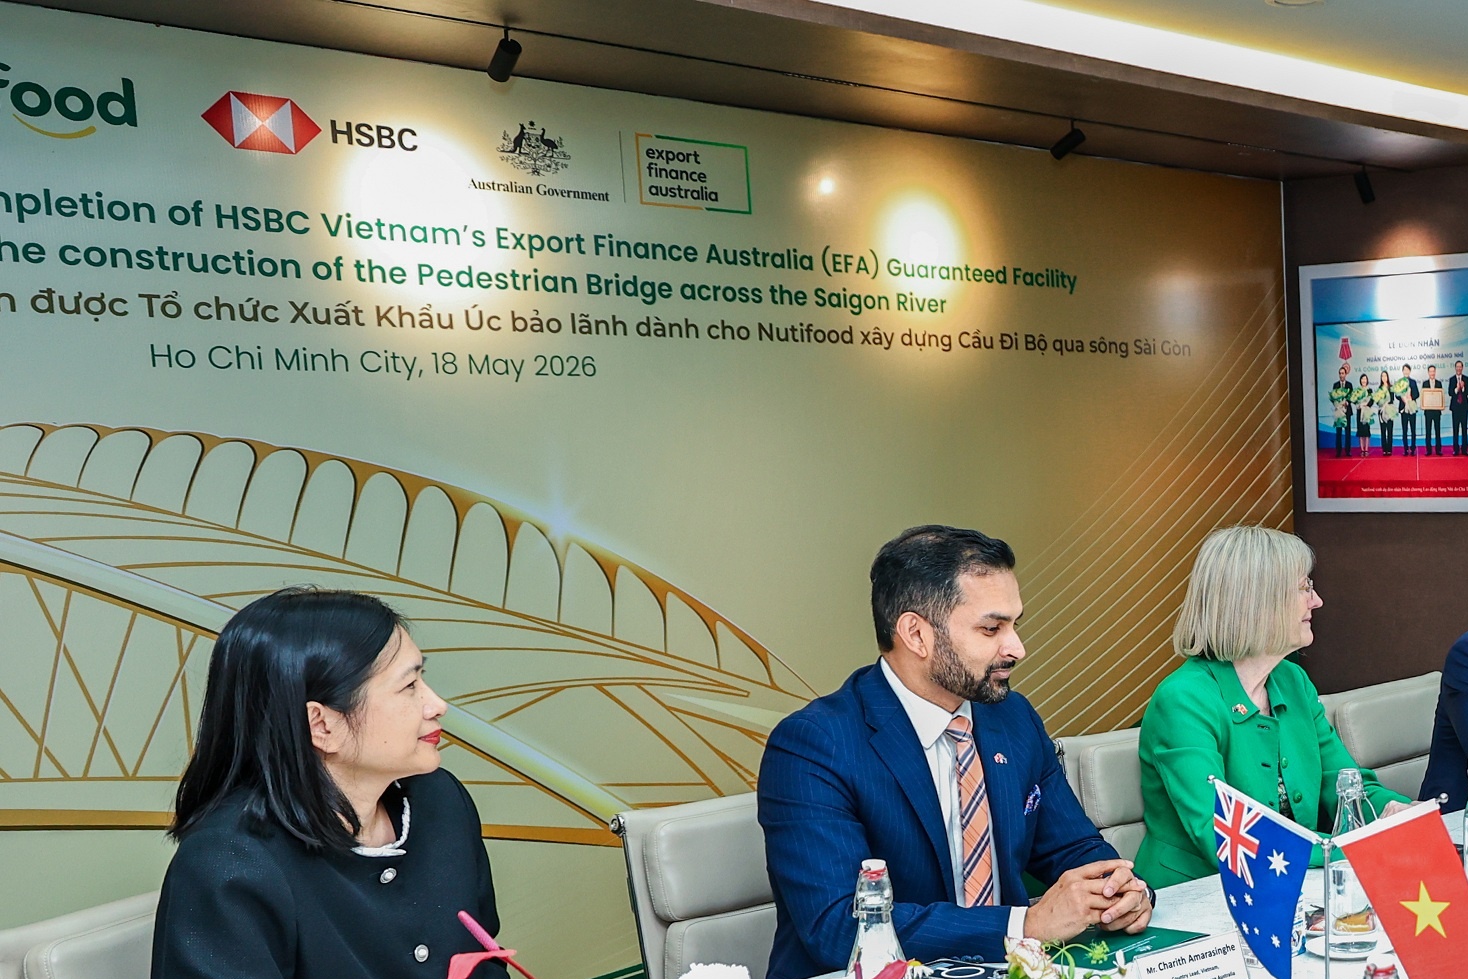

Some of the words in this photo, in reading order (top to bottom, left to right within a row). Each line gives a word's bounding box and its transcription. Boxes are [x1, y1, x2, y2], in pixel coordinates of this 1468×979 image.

[330, 119, 418, 151] HSBC
[645, 146, 701, 165] export
[646, 162, 707, 183] finance
[468, 178, 533, 195] Australian
[536, 183, 609, 202] Government
[648, 182, 719, 202] australia
[168, 199, 203, 227] of
[215, 203, 311, 235] HSBC
[496, 226, 586, 258] Export
[593, 233, 698, 263] Finance
[705, 243, 814, 271] Australia
[821, 245, 879, 279] (EFA)
[887, 258, 1007, 284] Guaranteed
[1012, 266, 1077, 295] Facility
[58, 245, 302, 280] construction
[312, 255, 343, 281] of
[354, 258, 407, 285] the
[417, 263, 578, 294] Pedestrian
[586, 273, 673, 305] Bridge
[680, 282, 763, 304] across
[769, 284, 807, 306] the
[814, 287, 890, 315] Saigon
[896, 291, 947, 314] River
[30, 287, 129, 322] được
[138, 290, 183, 319] Tổ
[193, 295, 280, 323] chức
[288, 300, 365, 326] Xuất
[375, 303, 454, 330] Khẩu
[464, 304, 502, 332] Úc
[511, 309, 562, 334] bảo
[570, 312, 628, 336] lãnh
[635, 316, 700, 340] dành
[706, 319, 751, 341] cho
[757, 322, 853, 345] Nutifood
[860, 327, 895, 350] xây
[901, 328, 951, 352] dựng
[958, 329, 994, 350] Cầu
[999, 332, 1018, 351] Đi
[1024, 332, 1048, 356] Bộ
[1052, 338, 1085, 356] qua
[1089, 336, 1129, 358] sông
[1133, 338, 1156, 356] Sài
[1160, 339, 1191, 357] Gòn
[150, 343, 196, 368] Ho
[208, 345, 263, 370] Chi
[275, 347, 349, 372] Minh
[360, 349, 424, 381] City,
[431, 352, 458, 375] 18
[468, 353, 525, 382] May
[533, 354, 597, 377] 2026
[1146, 966, 1157, 975] Mr.
[1158, 956, 1187, 971] Charith
[1188, 943, 1236, 963] Amarasinghe
[1217, 970, 1236, 979] Australia
